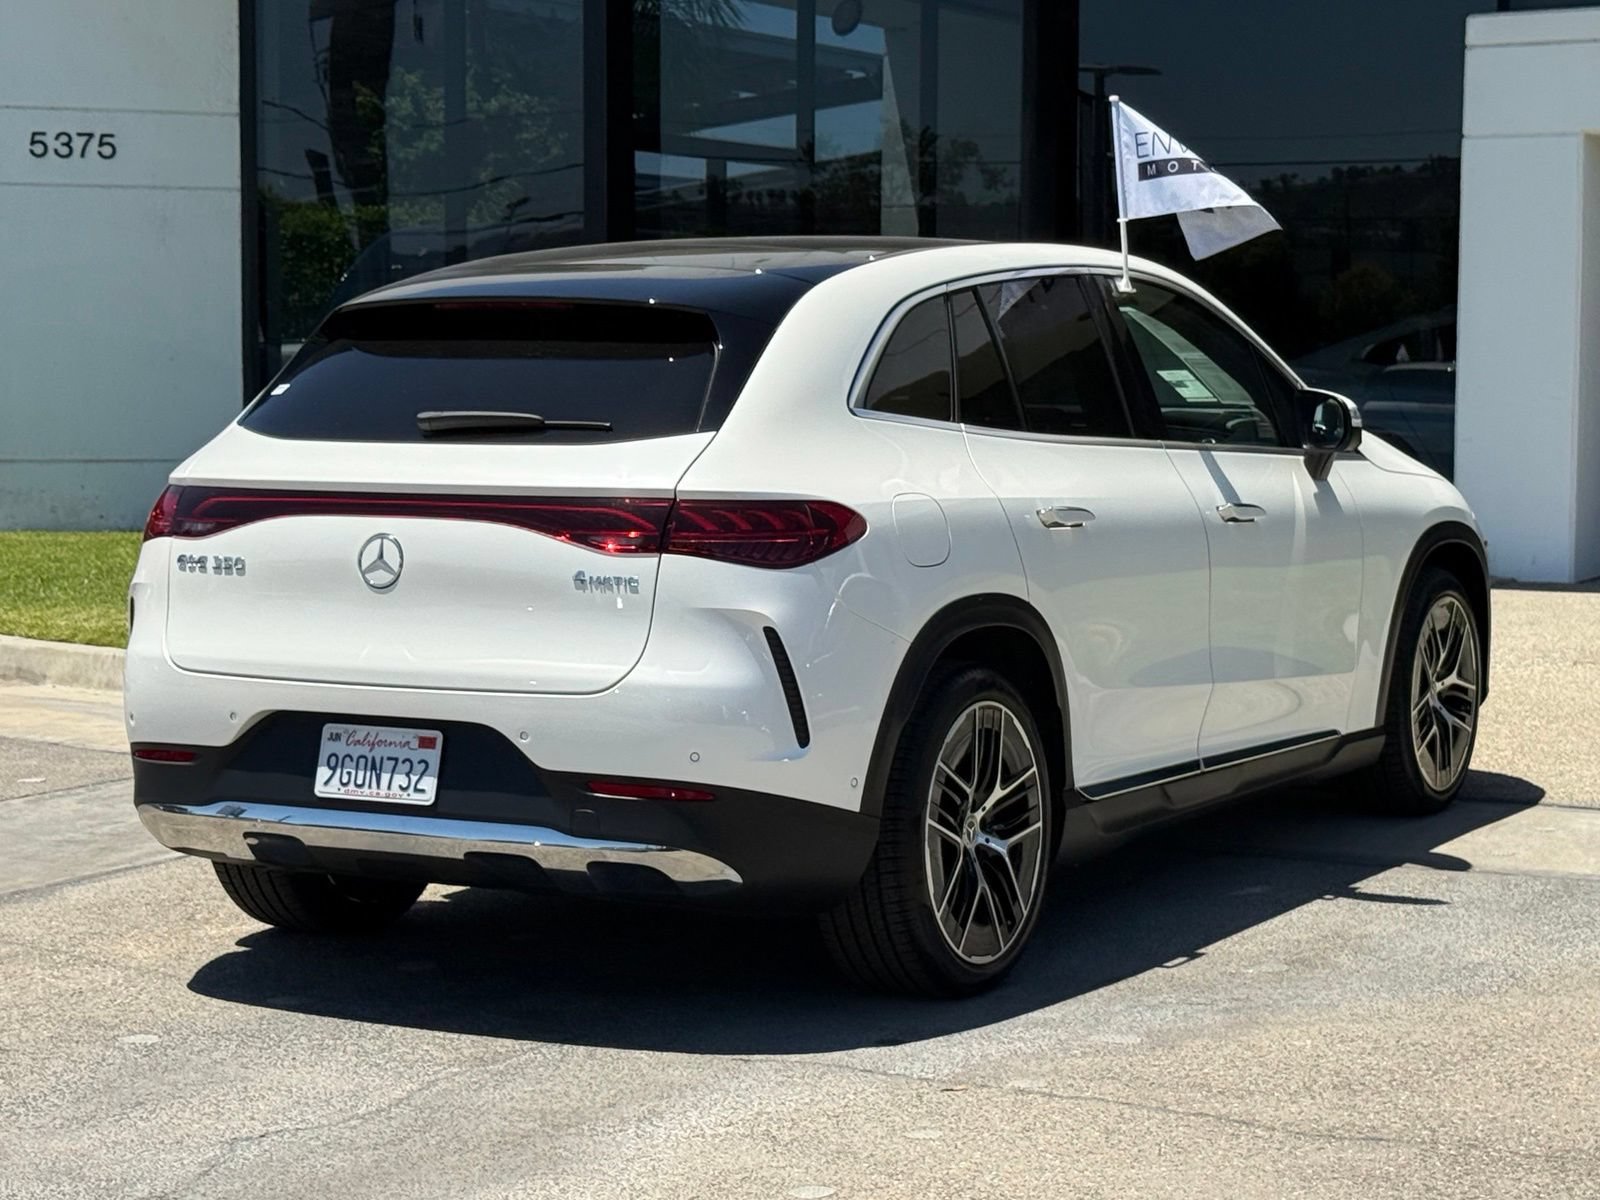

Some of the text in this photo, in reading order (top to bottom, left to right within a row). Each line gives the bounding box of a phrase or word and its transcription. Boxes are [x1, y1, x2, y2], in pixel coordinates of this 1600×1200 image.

[29, 131, 117, 160] 5375
[345, 729, 418, 752] California
[323, 752, 430, 794] 9GON732
